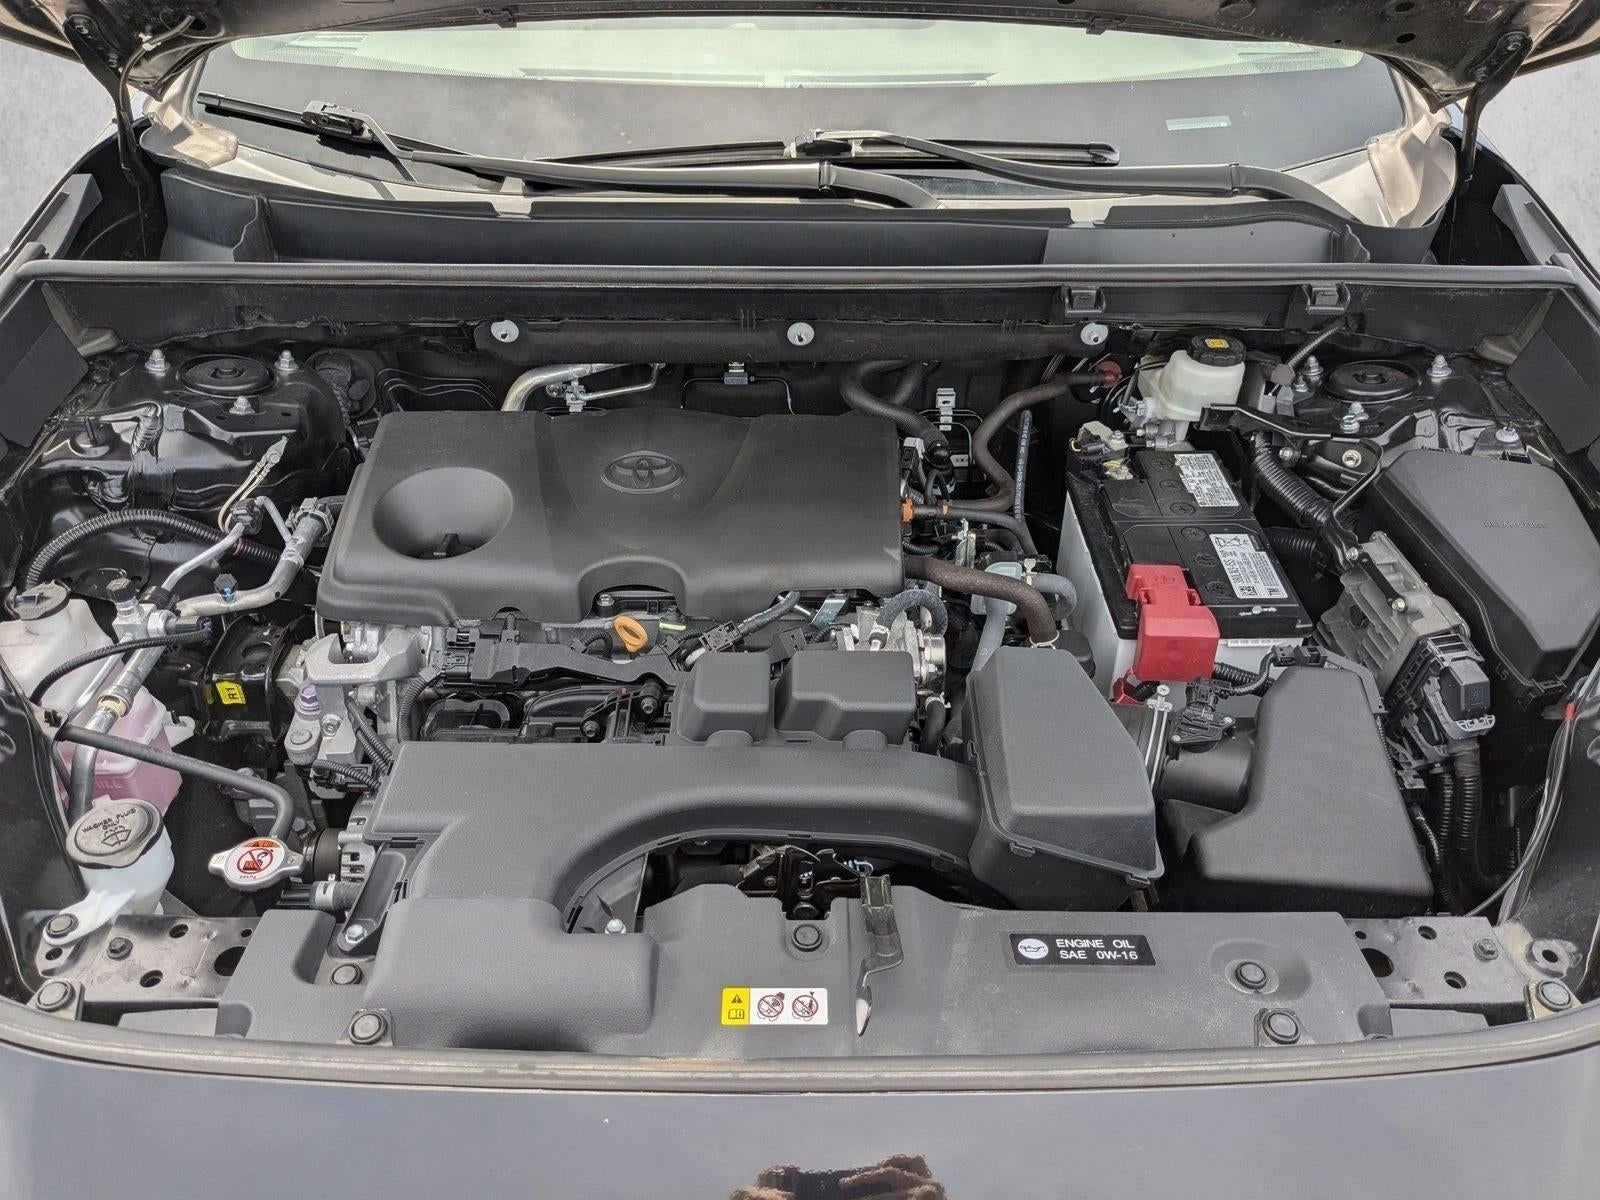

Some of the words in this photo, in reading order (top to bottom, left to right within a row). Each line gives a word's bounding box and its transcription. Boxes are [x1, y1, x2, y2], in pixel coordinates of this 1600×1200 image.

[81, 817, 113, 833] WASHER
[116, 808, 136, 819] FLUID
[102, 819, 120, 831] ONLY
[1055, 938, 1105, 949] ENGINE
[1112, 939, 1136, 949] OIL
[1059, 950, 1088, 960] SAE
[1096, 950, 1139, 961] 0W-16
